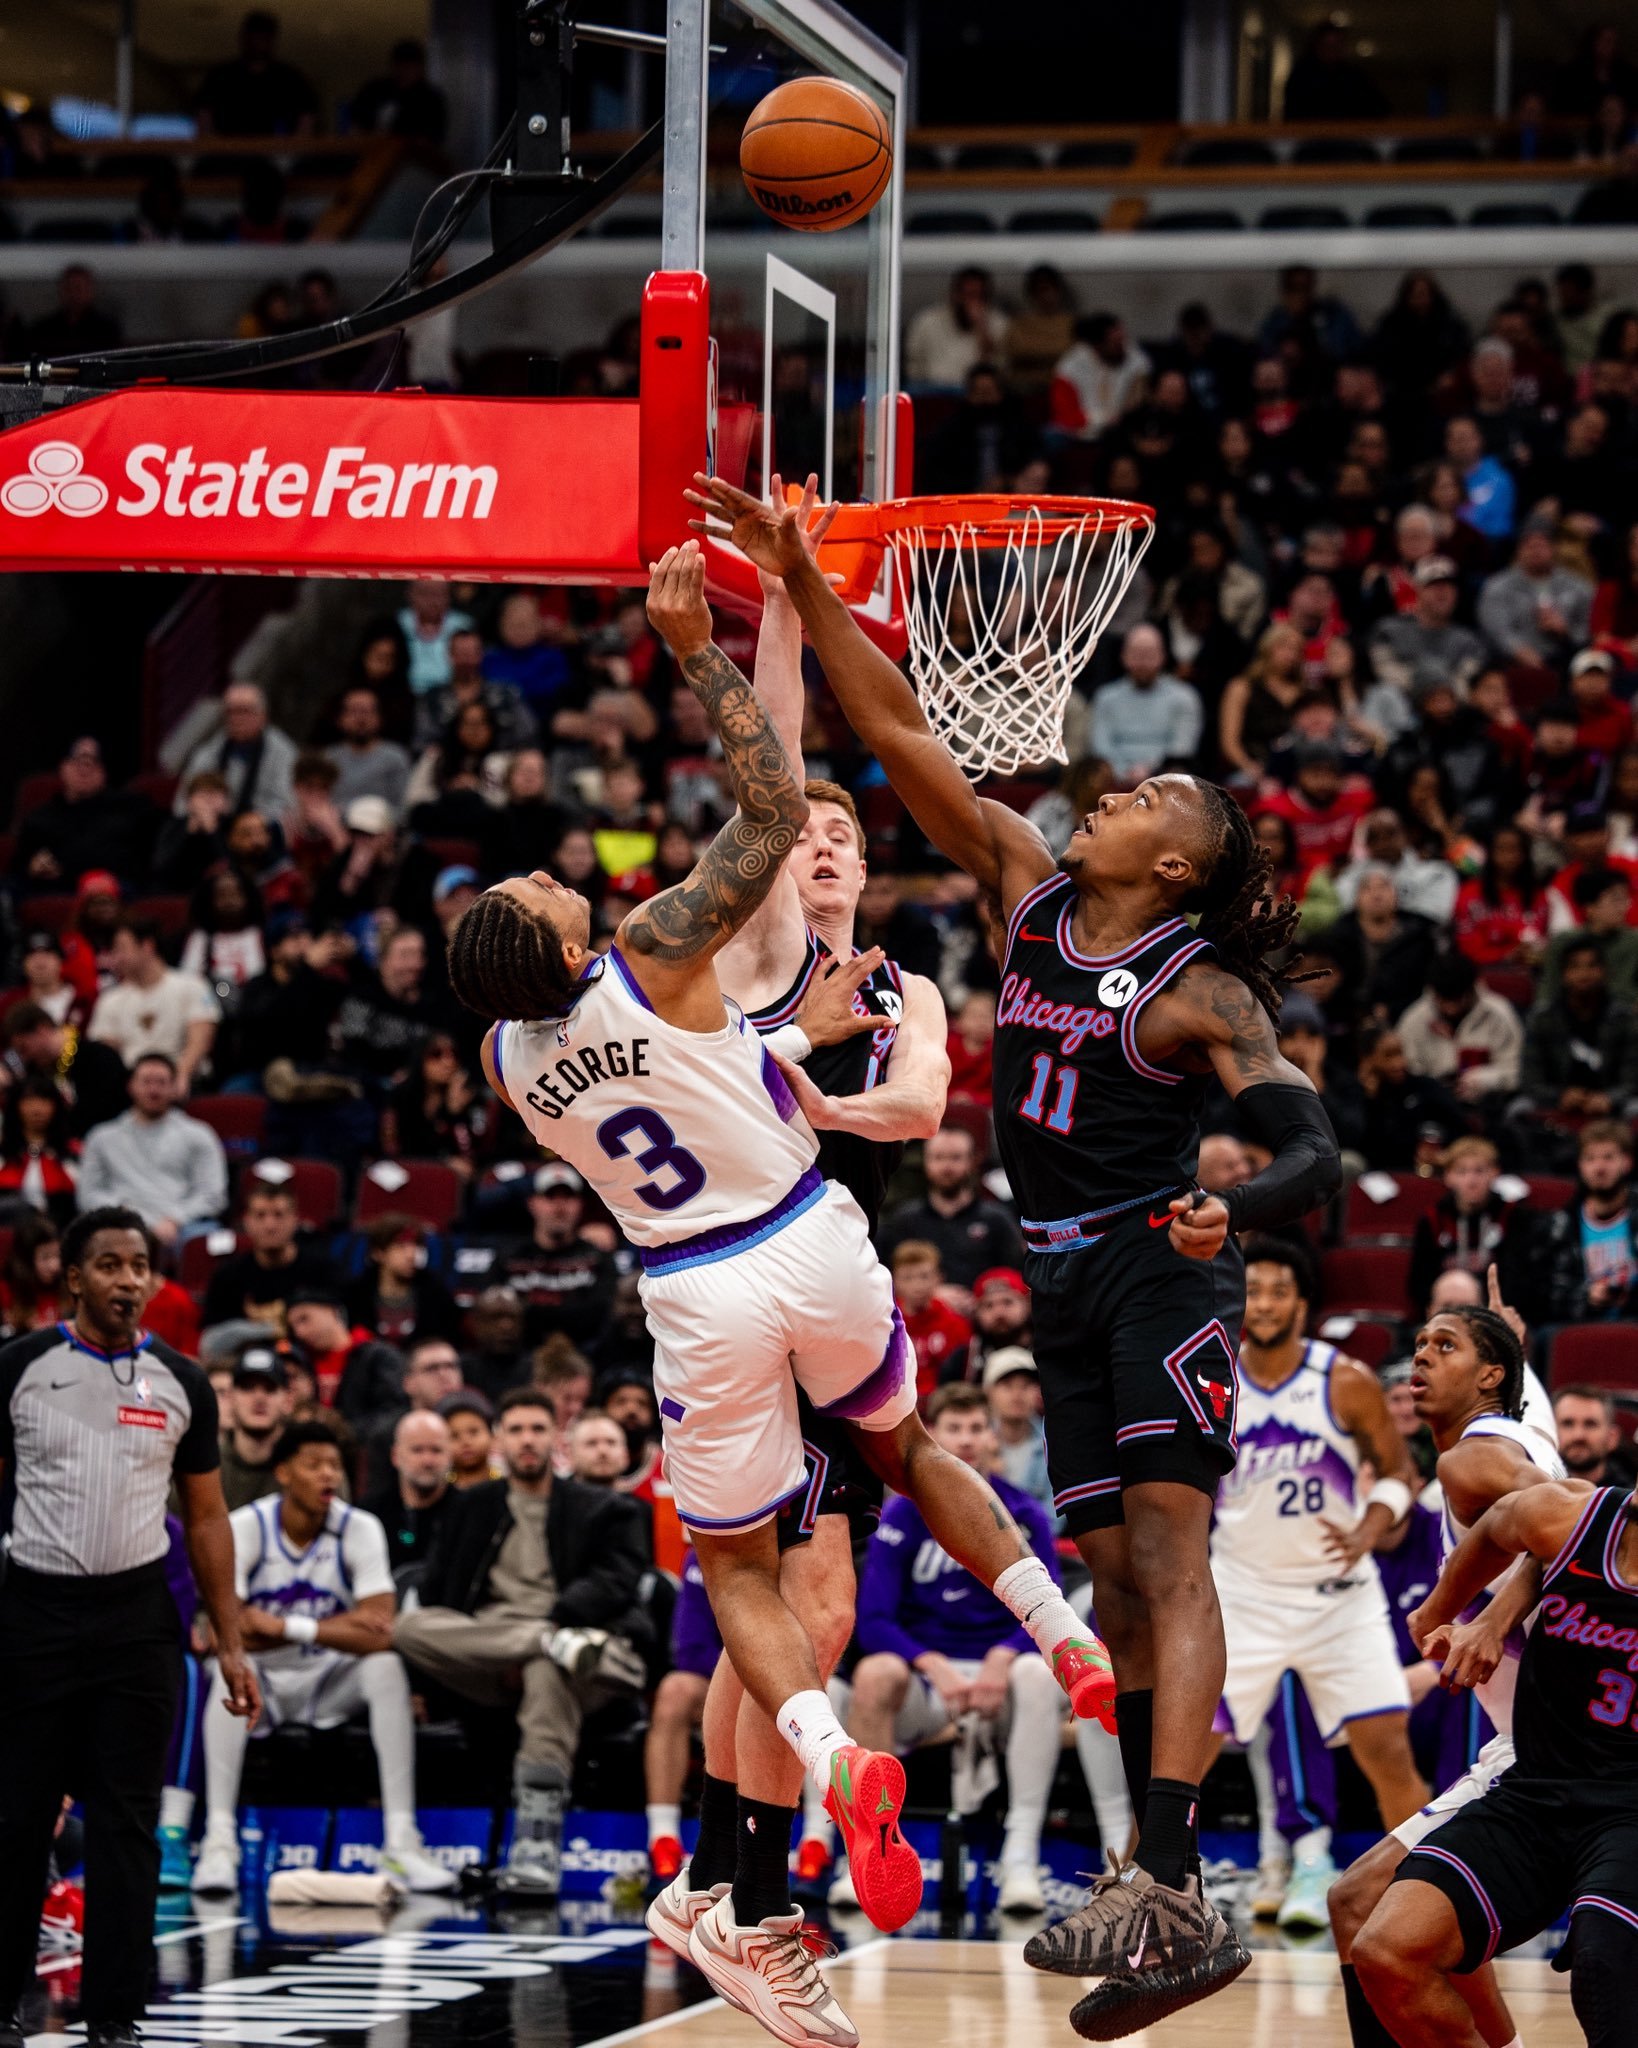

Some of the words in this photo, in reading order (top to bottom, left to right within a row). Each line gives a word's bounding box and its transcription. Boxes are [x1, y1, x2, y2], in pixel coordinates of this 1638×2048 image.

[753, 184, 853, 216] Wilson
[997, 972, 1118, 1056] Chicago
[526, 1038, 650, 1120] GEORGE
[1018, 1052, 1079, 1136] 11
[596, 1106, 707, 1212] 3
[1048, 1227, 1080, 1243] BULLS
[1224, 1438, 1328, 1497] UTAH
[1277, 1477, 1325, 1518] 28
[1588, 1668, 1638, 1736] 3
